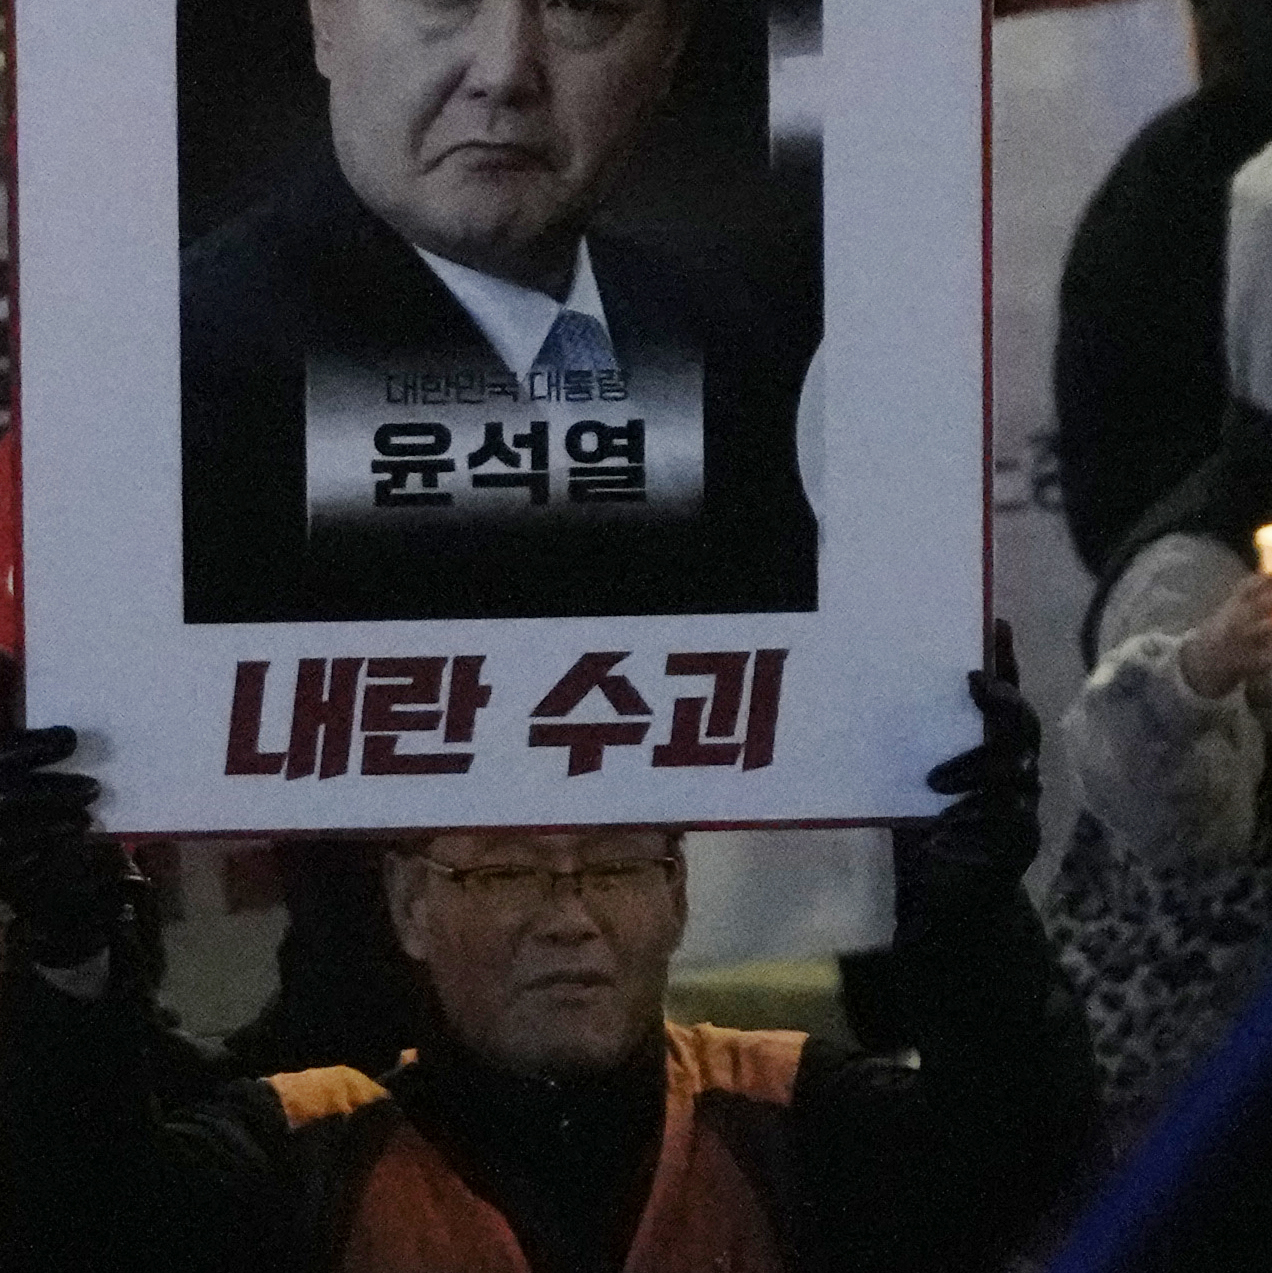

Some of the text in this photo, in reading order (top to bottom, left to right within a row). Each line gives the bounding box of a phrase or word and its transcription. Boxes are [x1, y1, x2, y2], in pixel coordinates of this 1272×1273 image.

[386, 369, 629, 405] 대한민국 대통령
[371, 419, 647, 507] 윤석열
[224, 648, 790, 781] 내란 수괴
